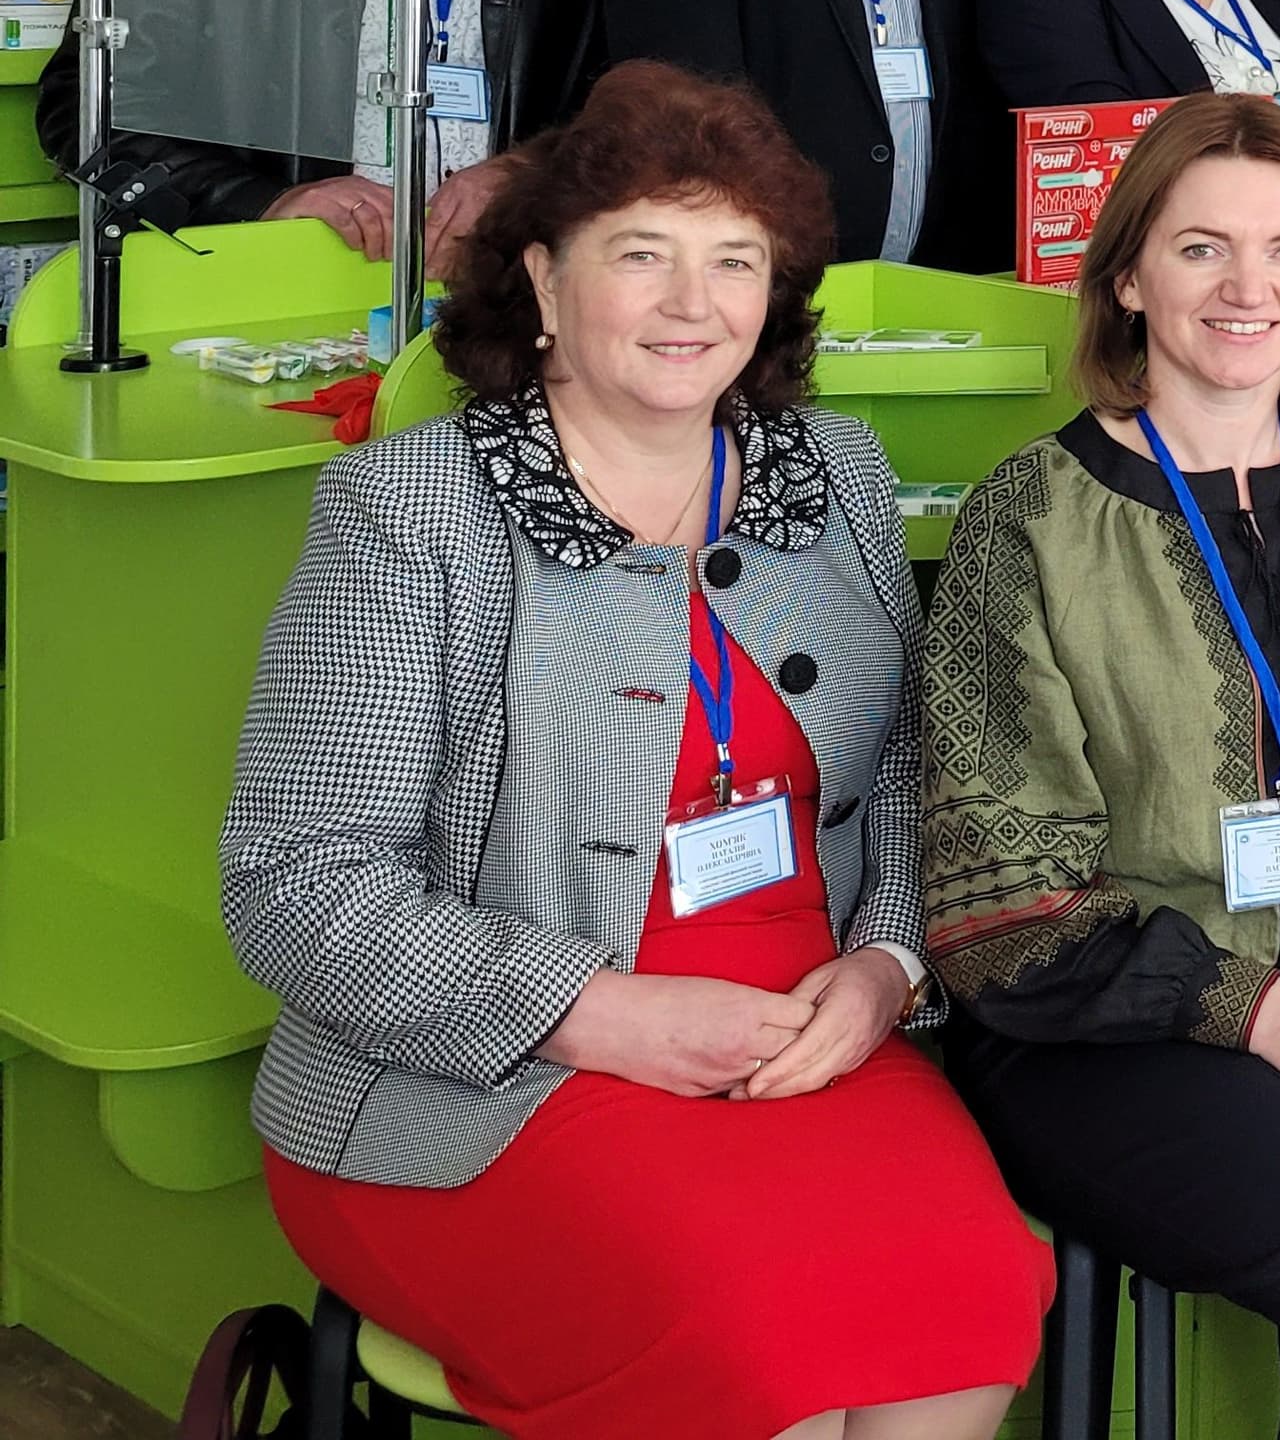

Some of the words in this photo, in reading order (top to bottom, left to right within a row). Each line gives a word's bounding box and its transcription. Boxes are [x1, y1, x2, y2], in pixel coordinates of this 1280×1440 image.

[1041, 115, 1087, 138] Ренні
[1032, 148, 1076, 170] Ренні
[1032, 217, 1076, 239] Ренні
